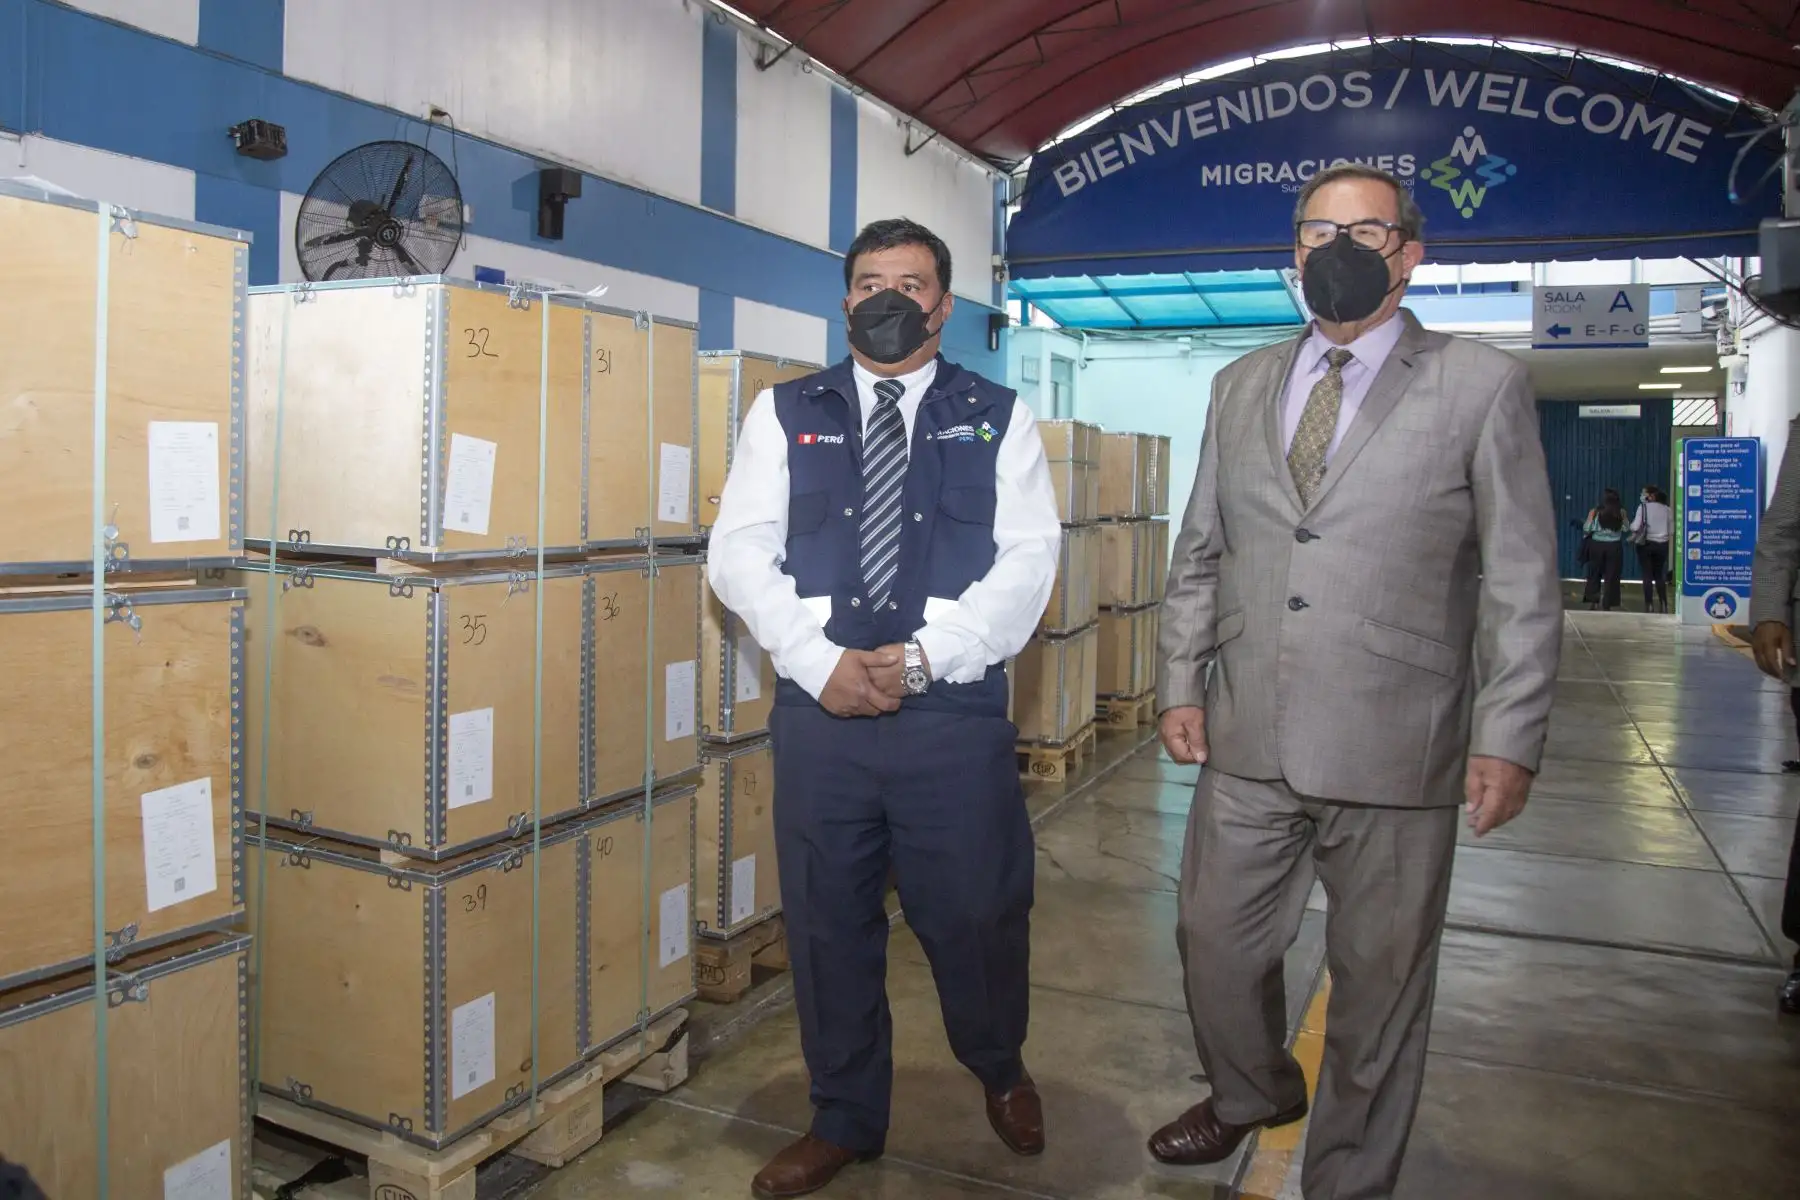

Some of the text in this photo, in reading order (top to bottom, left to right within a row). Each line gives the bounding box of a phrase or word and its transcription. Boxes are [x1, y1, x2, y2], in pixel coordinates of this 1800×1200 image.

[1052, 70, 1373, 197] BIENVENIDOS
[1424, 69, 1712, 164] WELCOME
[1544, 290, 1634, 313] SALA A
[1544, 304, 1582, 314] ROOM
[464, 328, 499, 358] 32
[596, 349, 613, 374] 31
[817, 434, 844, 444] PERÚ
[600, 592, 621, 621] 36
[459, 614, 488, 646] 35
[596, 836, 613, 860] 40
[462, 883, 487, 912] 39
